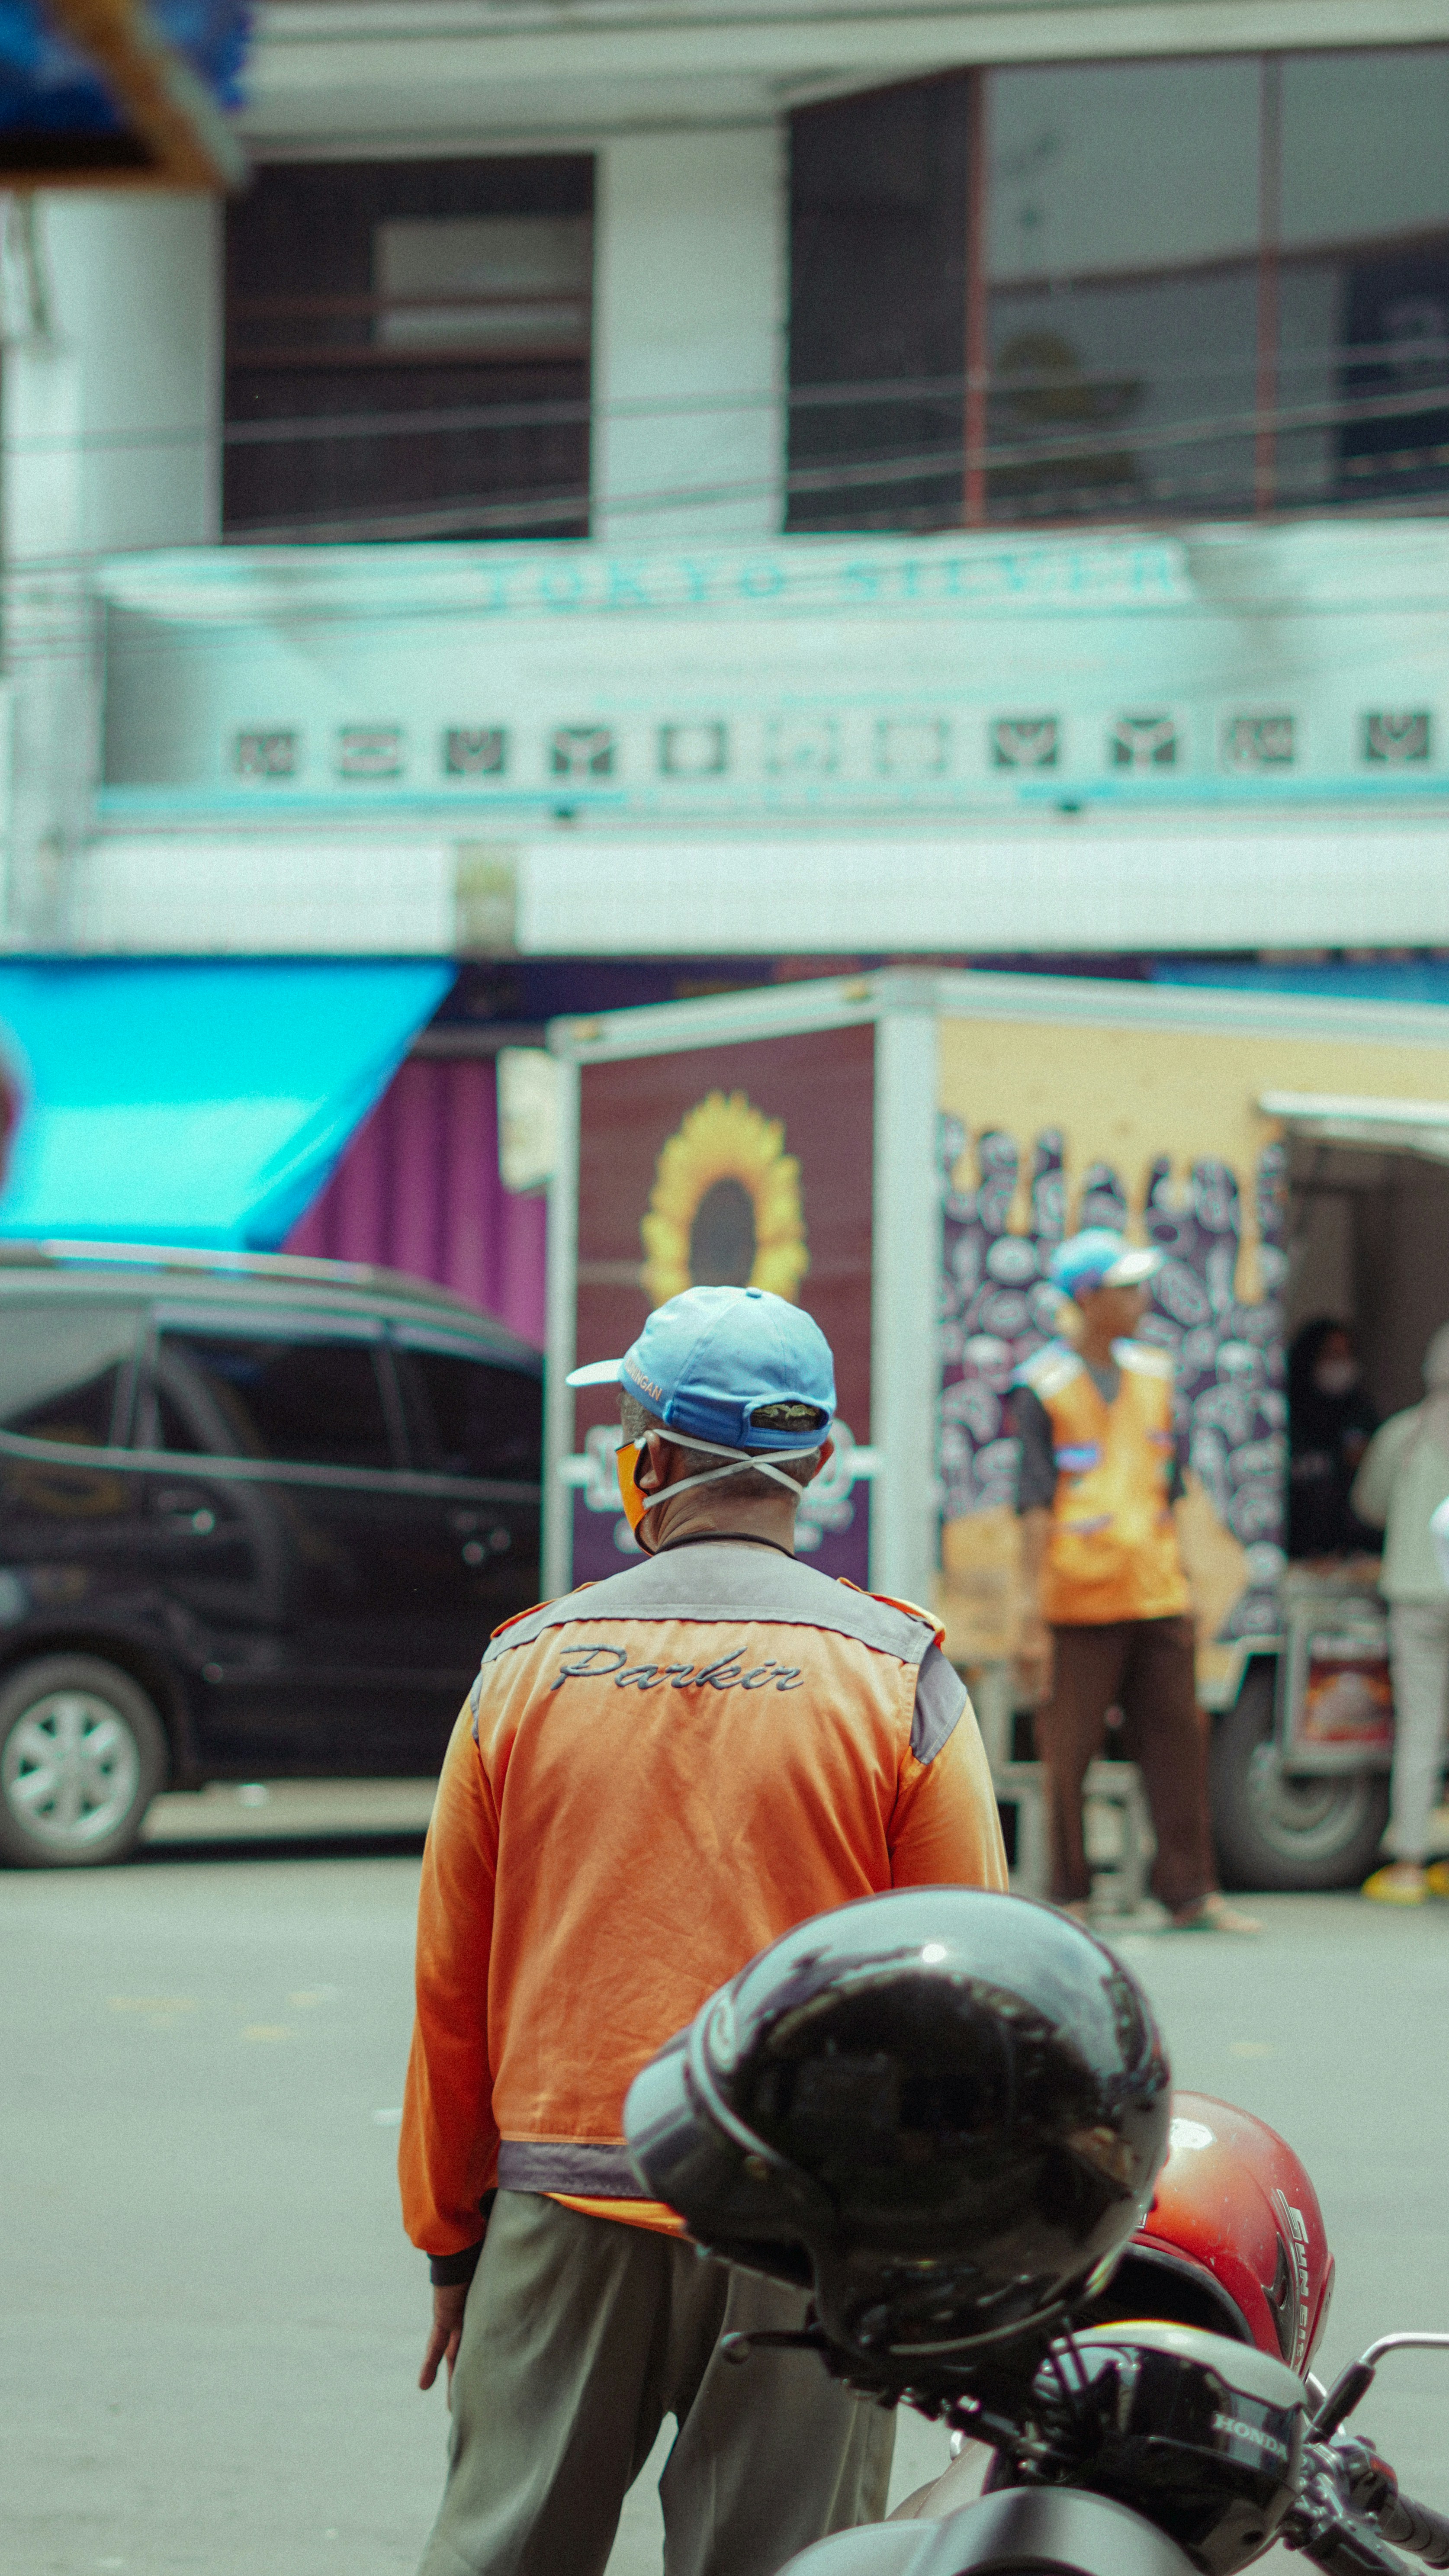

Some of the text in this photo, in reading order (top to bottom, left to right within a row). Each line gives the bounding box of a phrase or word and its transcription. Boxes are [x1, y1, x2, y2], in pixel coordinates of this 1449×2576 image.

[480, 558, 787, 609] TOKYO
[550, 1644, 803, 1691] Parkir
[1213, 2411, 1289, 2461] HONDA
